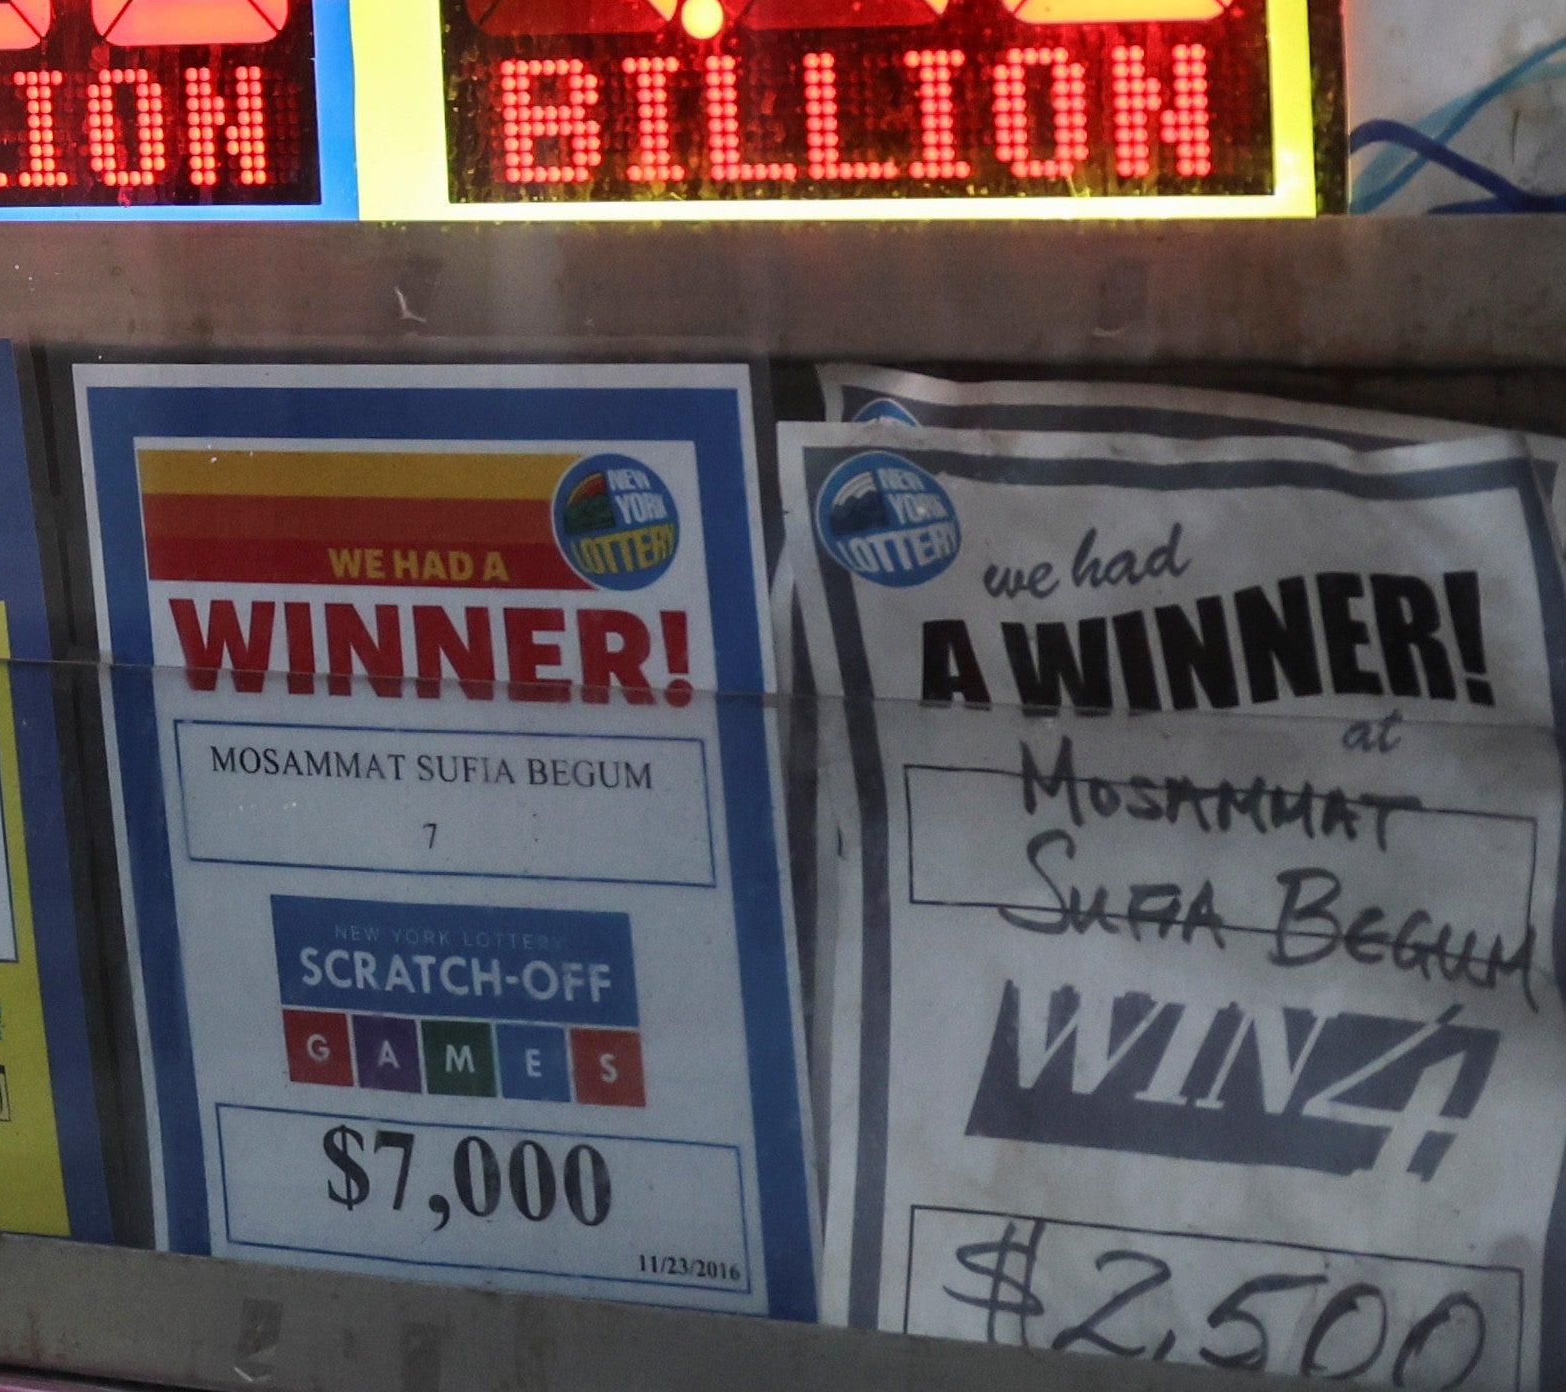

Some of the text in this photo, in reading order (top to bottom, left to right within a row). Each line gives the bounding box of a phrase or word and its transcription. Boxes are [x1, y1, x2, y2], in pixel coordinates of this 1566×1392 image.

[500, 44, 1213, 185] BILLION
[606, 467, 654, 492] NEW
[879, 467, 927, 493] NEW
[614, 492, 669, 525] YORK
[891, 491, 950, 524] YORK
[328, 547, 510, 583] WE HAD A
[570, 519, 675, 575] LOTTERY
[835, 520, 958, 574] LOTTERY
[983, 522, 1193, 600] we had
[168, 597, 694, 708] WINNER!
[920, 571, 1497, 719] A WINNER!
[1341, 710, 1405, 755] at
[210, 745, 654, 792] MOSAMMAT SUFIA BEGUM
[422, 822, 439, 851] 7
[334, 922, 566, 953] NEW YORK LOTTERY
[300, 945, 612, 1004] SCRATCH-OFF
[307, 1033, 620, 1085] GAMES
[322, 1124, 613, 1232] $7,000
[637, 1253, 742, 1283] 11/23/2016
